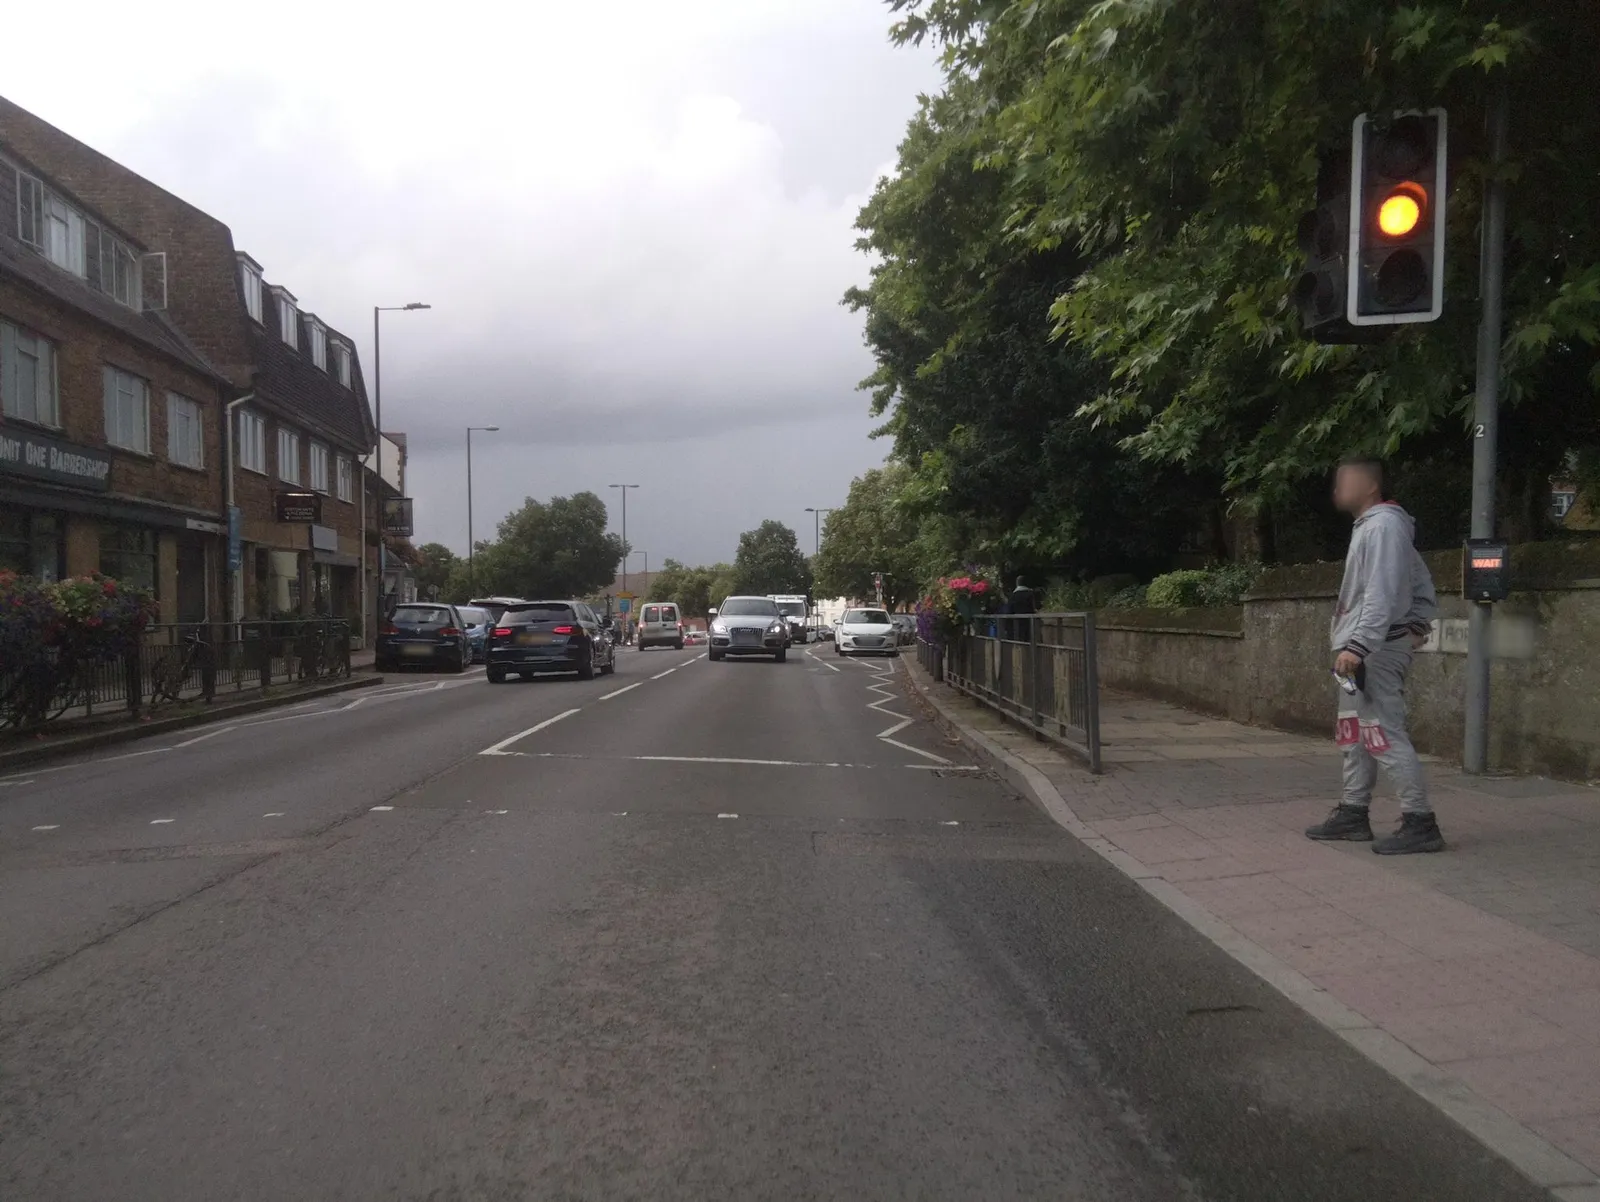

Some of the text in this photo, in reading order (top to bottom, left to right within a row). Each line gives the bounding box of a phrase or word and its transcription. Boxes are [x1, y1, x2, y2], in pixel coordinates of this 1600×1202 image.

[1475, 424, 1485, 438] 2
[25, 441, 47, 468] ONE
[50, 446, 109, 480] BARBERSHOP
[1473, 559, 1501, 568] WAIT
